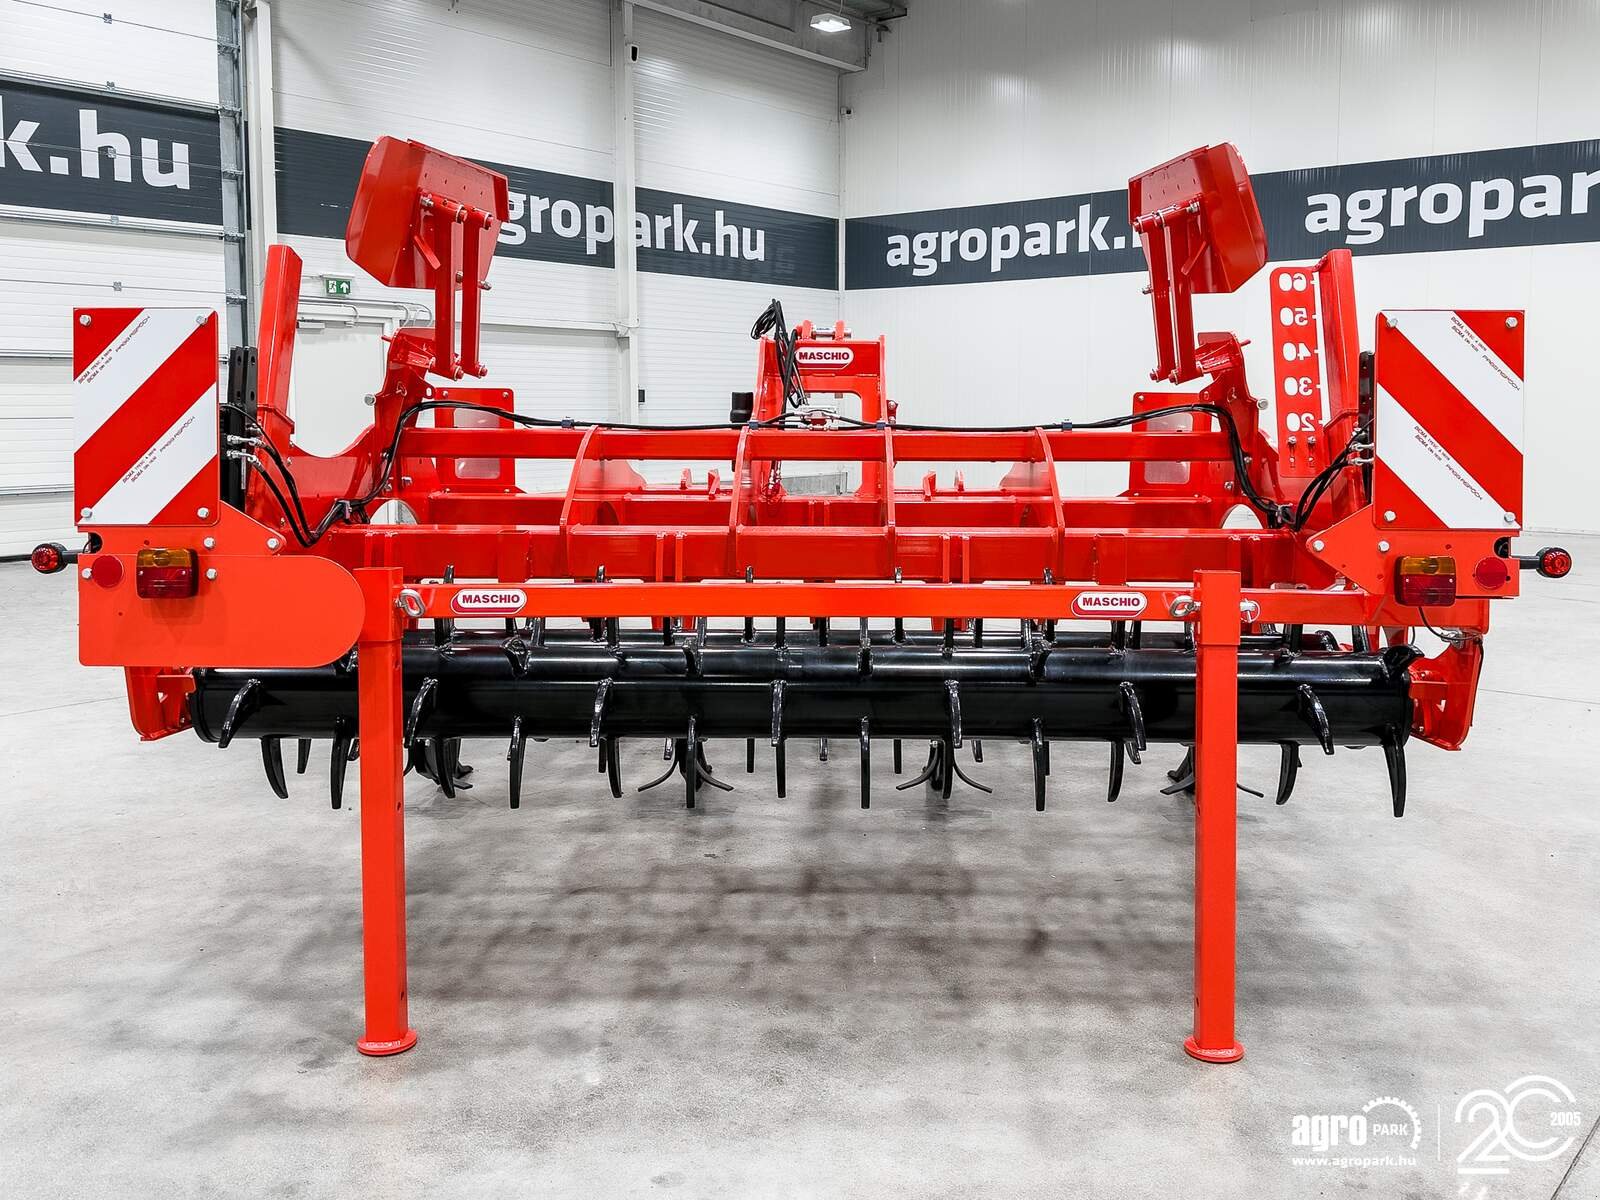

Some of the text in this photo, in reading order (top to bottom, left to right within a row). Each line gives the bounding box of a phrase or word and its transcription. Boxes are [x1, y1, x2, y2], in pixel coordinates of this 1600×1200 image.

[798, 351, 850, 361] MASCHIO
[462, 594, 521, 604] MASCHIO
[1082, 597, 1141, 607] MASCHIO
